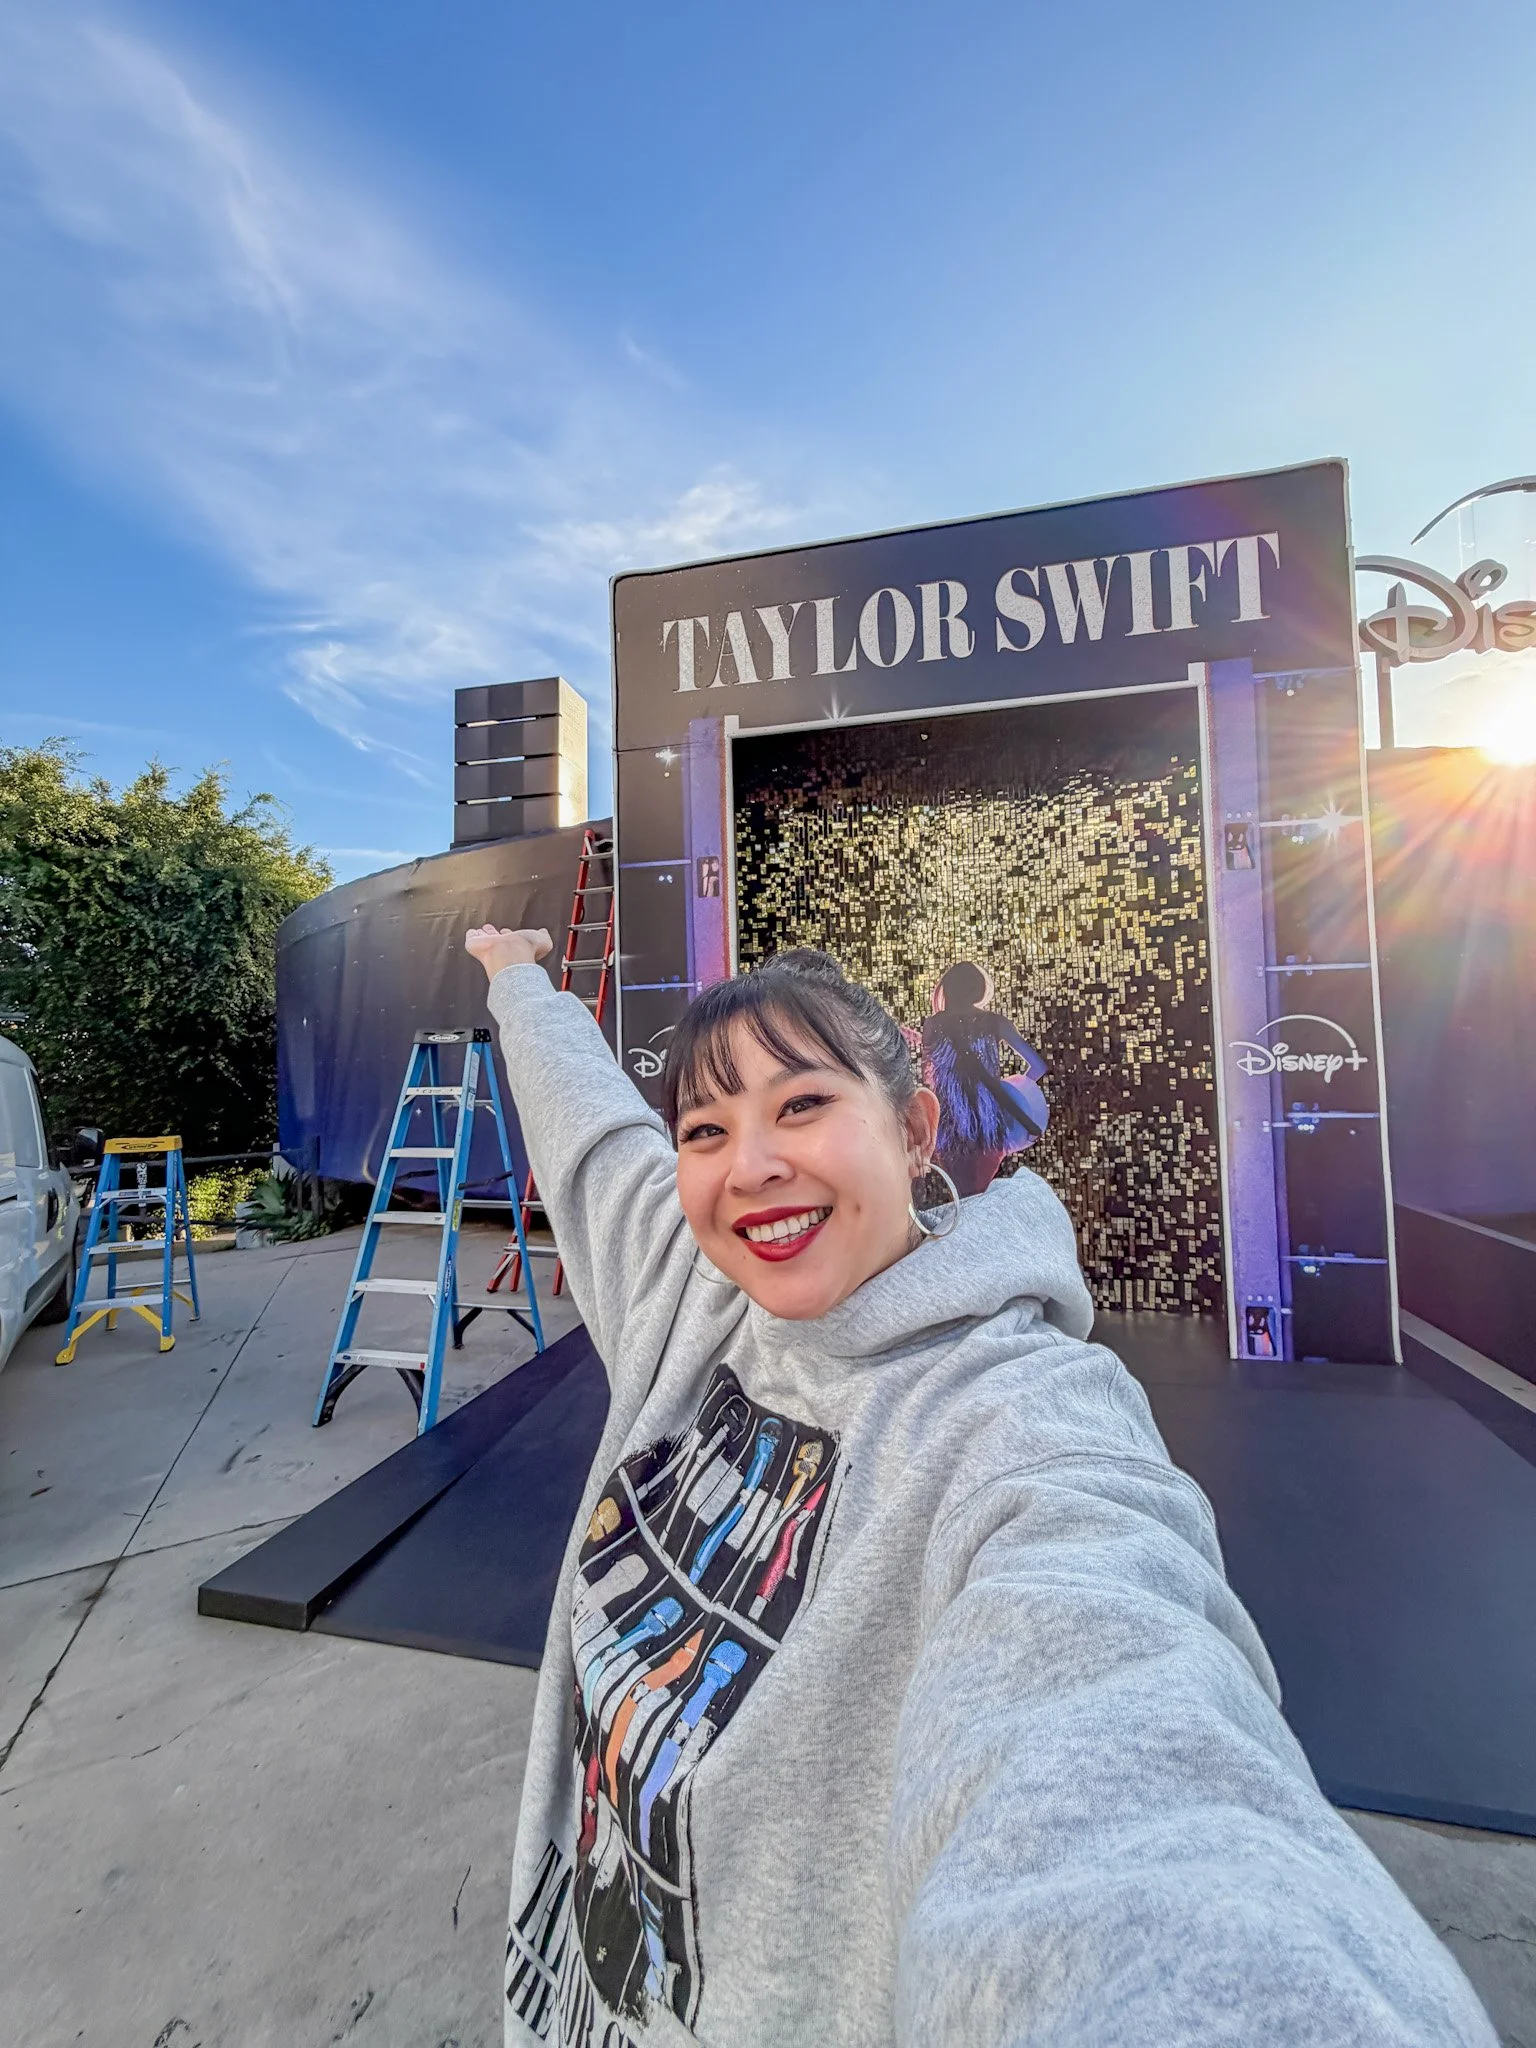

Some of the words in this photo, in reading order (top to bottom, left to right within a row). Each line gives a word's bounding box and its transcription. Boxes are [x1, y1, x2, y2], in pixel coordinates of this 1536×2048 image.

[663, 579, 976, 694] TAYLOR
[994, 530, 1281, 653] SWIFT
[1228, 1041, 1369, 1083] Disney+
